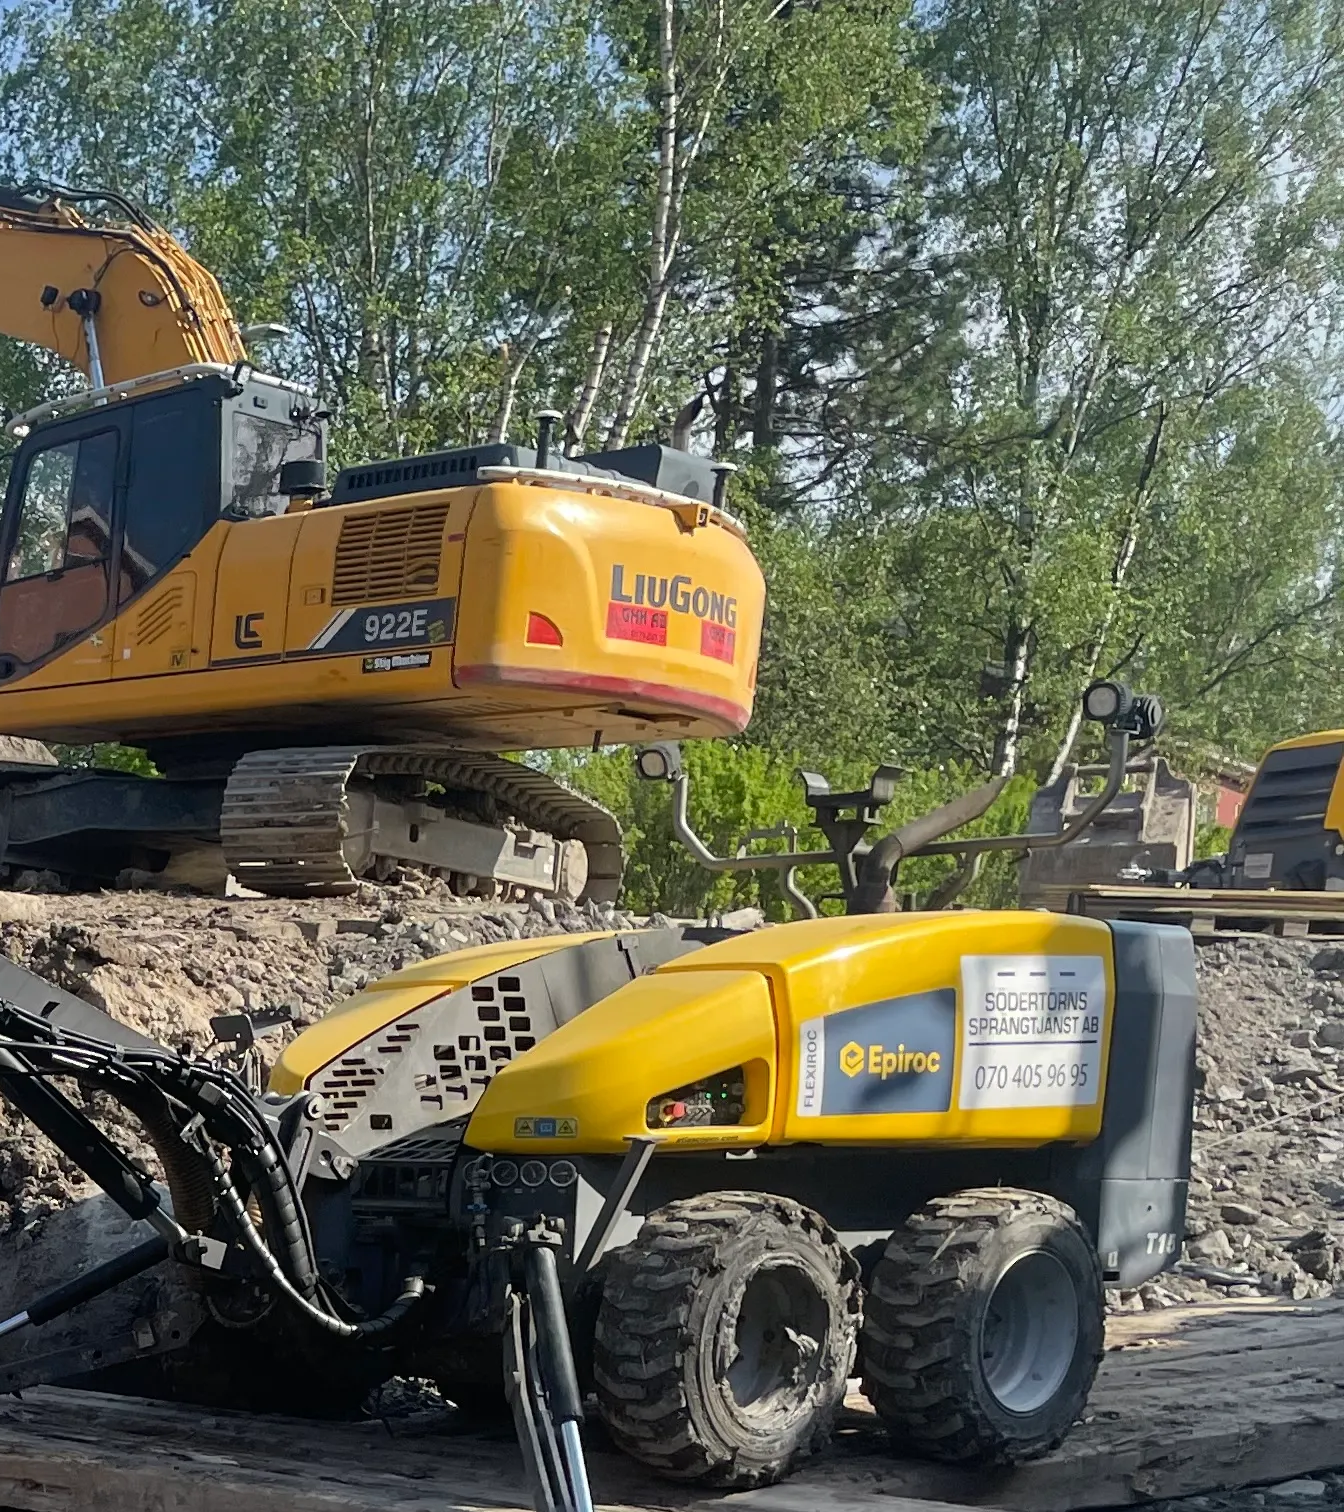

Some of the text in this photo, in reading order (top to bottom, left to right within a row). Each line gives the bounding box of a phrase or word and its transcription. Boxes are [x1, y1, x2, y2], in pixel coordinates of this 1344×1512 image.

[364, 608, 429, 642] 922E
[985, 987, 1088, 1012] SÖDERTÖRNS
[968, 1013, 1099, 1035] SPRÄNGTJÄNST AB
[803, 1029, 818, 1108] FLEXIROC
[868, 1043, 941, 1080] Epiroc
[975, 1063, 1089, 1090] 070 405 96 95
